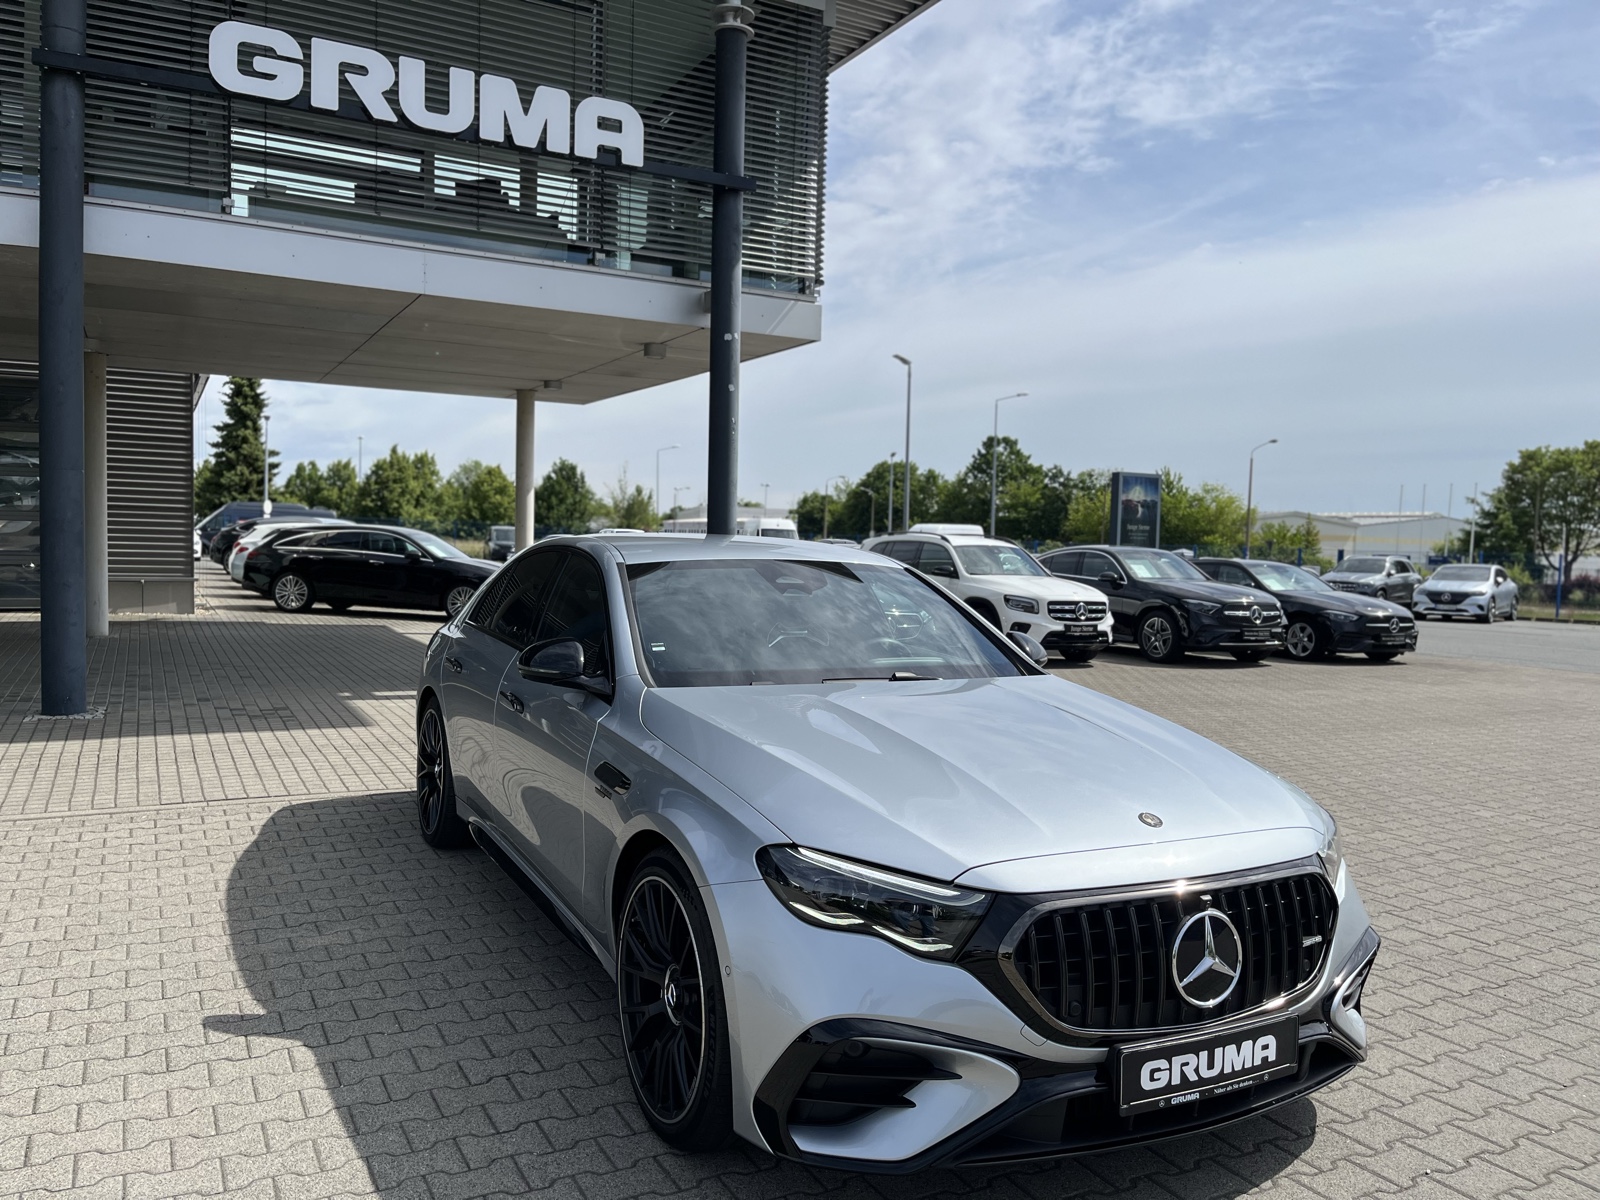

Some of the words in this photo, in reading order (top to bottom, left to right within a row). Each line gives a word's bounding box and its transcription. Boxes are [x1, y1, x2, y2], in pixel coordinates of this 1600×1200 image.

[208, 20, 644, 167] GRUMA
[704, 1013, 716, 1098] MICHELIN
[1140, 1034, 1277, 1091] GRUMA
[1171, 1092, 1200, 1105] GRUMA
